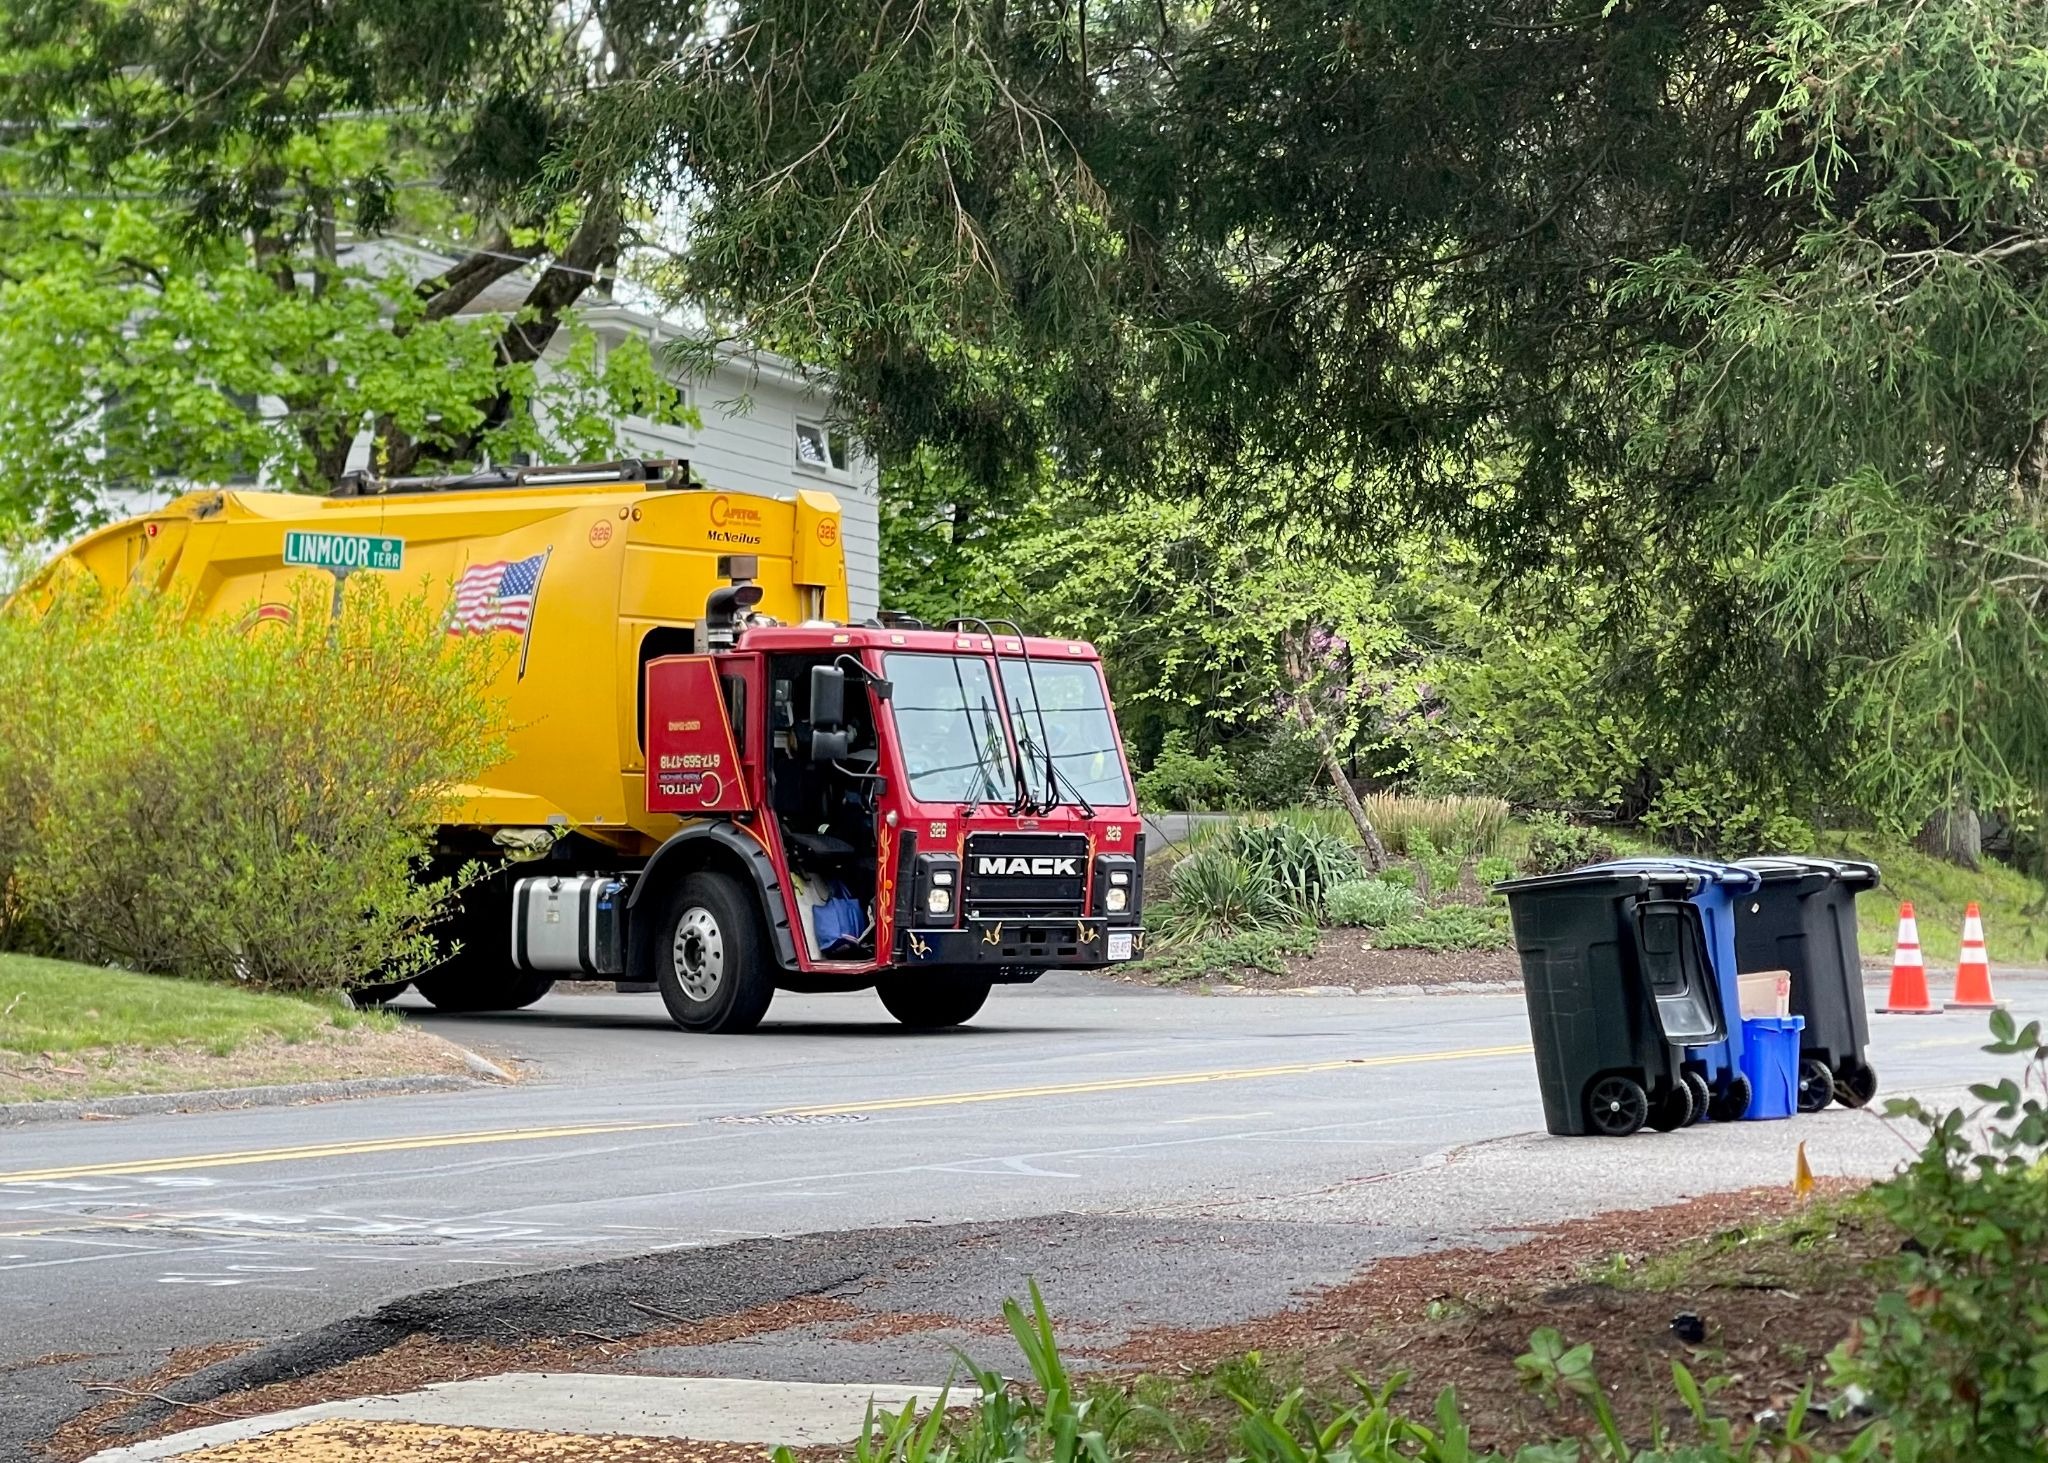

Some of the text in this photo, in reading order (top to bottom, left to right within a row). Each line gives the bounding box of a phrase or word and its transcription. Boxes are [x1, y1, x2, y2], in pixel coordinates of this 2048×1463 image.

[710, 495, 761, 529] CAPITOL
[592, 527, 611, 541] 326
[707, 530, 761, 545] McNeilus
[819, 525, 836, 541] 326
[287, 533, 399, 568] LINMOOR TERR
[659, 771, 722, 807] CAPITOL
[1105, 825, 1122, 842] 326
[978, 857, 1076, 876] MACK
